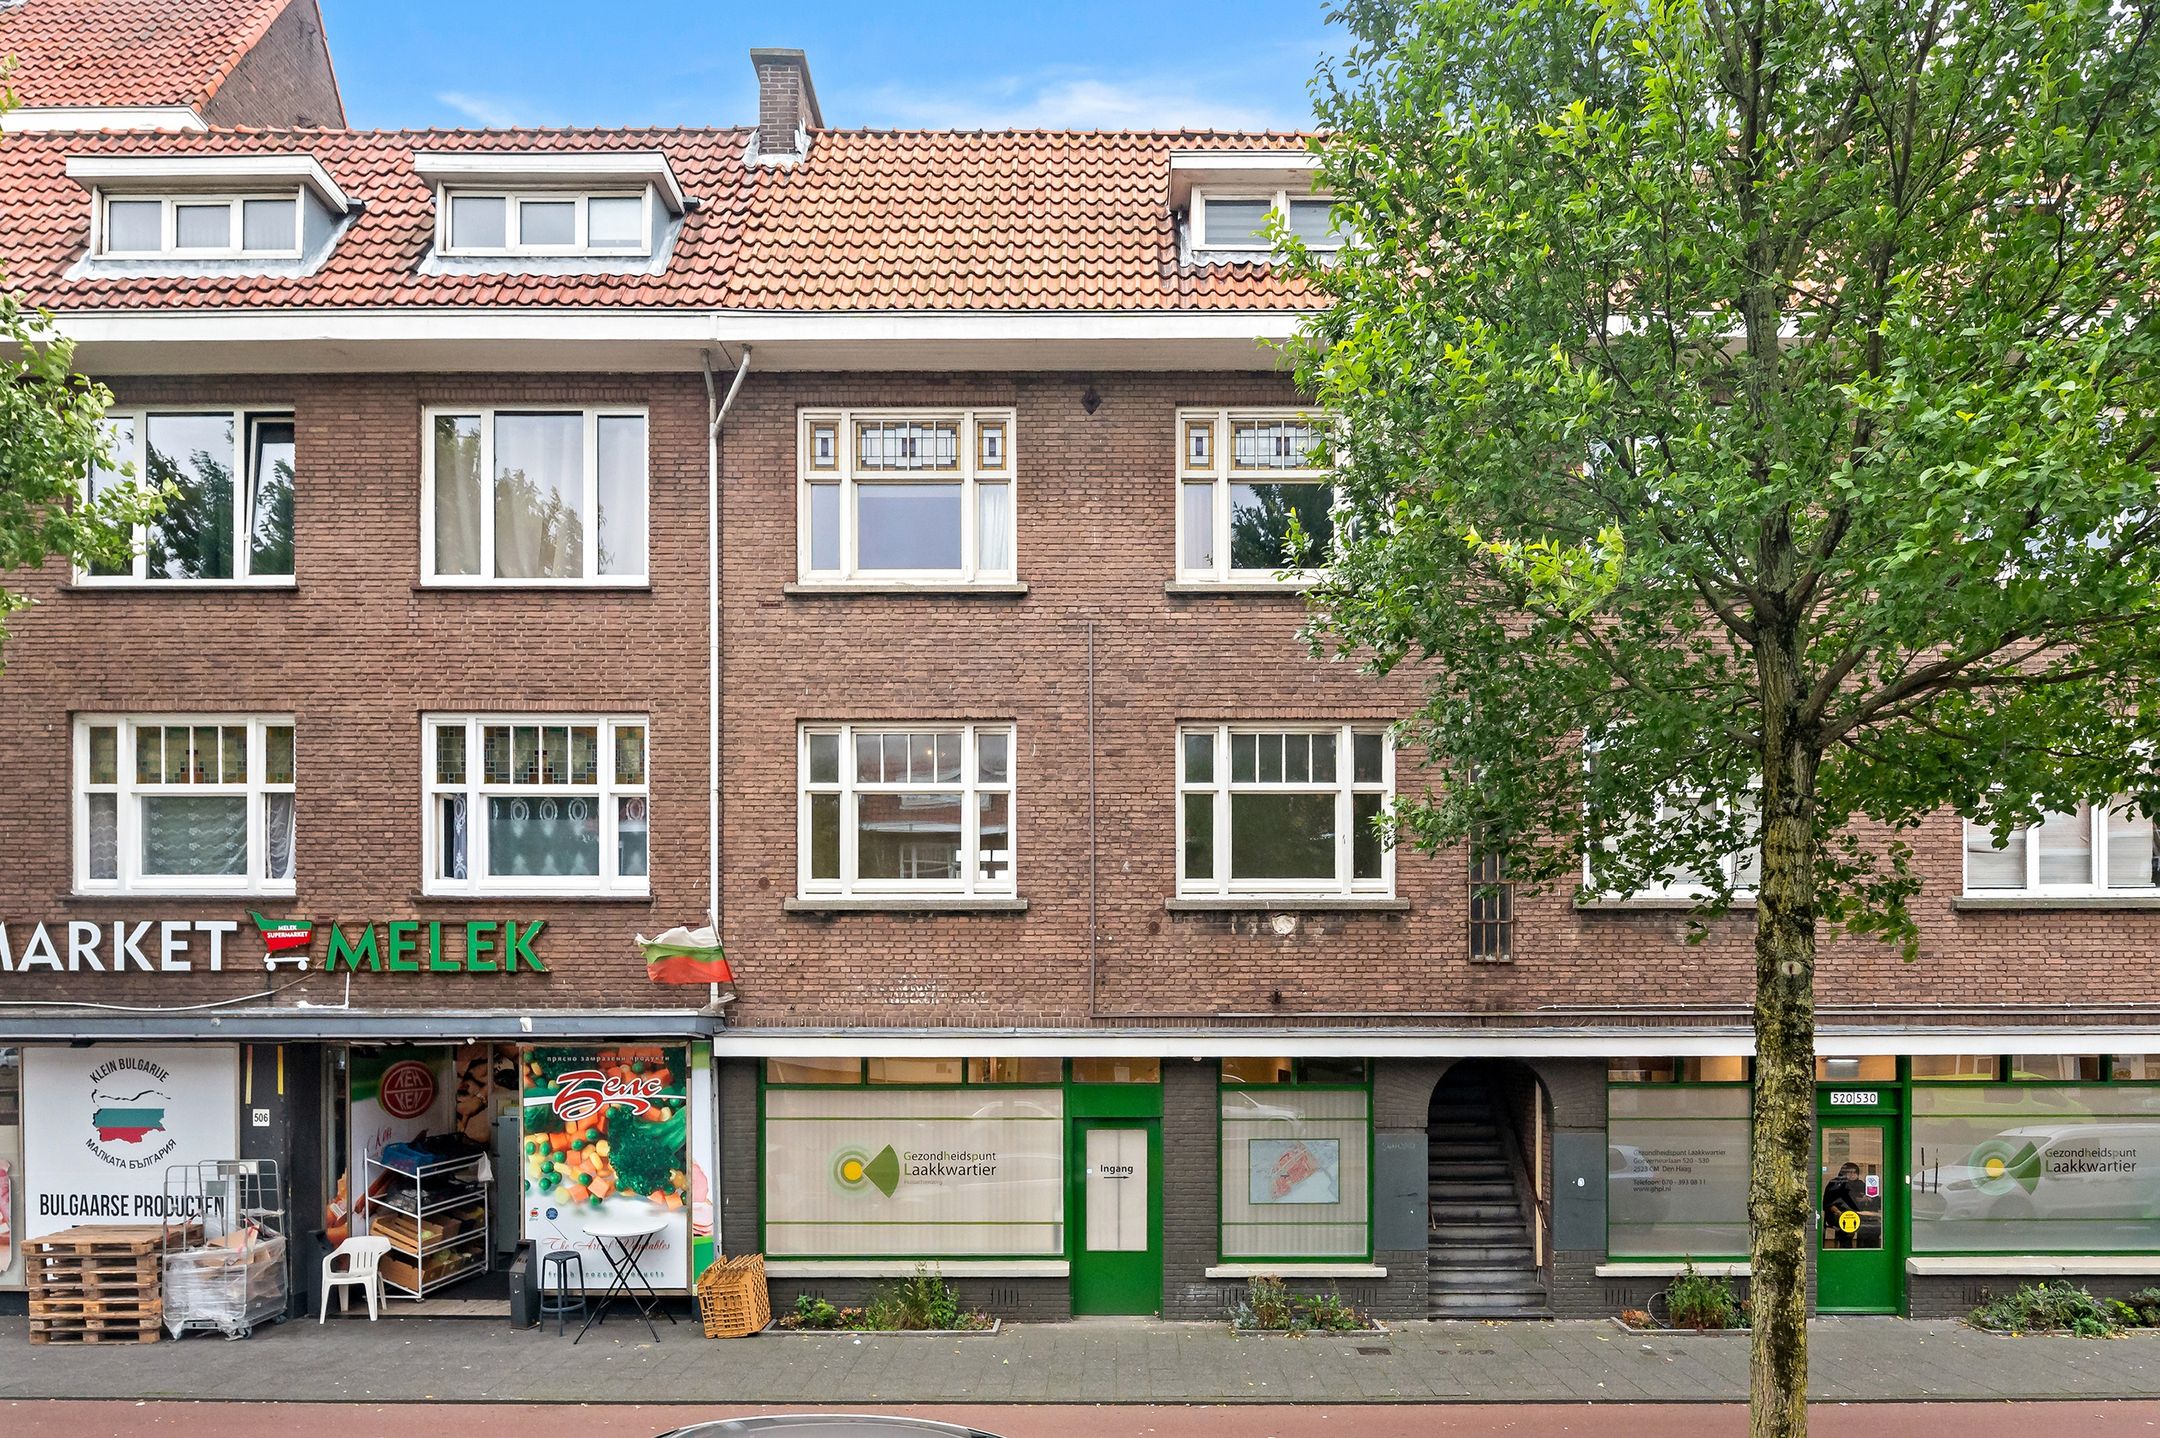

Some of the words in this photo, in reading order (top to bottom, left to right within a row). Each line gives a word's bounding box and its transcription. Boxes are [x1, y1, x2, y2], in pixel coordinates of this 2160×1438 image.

[0, 920, 238, 971] ARKET
[325, 919, 550, 972] MELEK
[89, 1060, 117, 1083] KLEIN
[118, 1057, 169, 1082] BULGARIJE
[1833, 1093, 1853, 1103] 520
[1856, 1093, 1876, 1103] 530
[254, 1113, 268, 1122] 506
[85, 1138, 126, 1168] МАЛКАТА
[129, 1138, 177, 1169] БЪЛГАРИЯ
[904, 1151, 996, 1162] Gezondheidspunt
[1634, 1149, 1687, 1157] Gezondheidspunt
[2045, 1148, 2136, 1158] Gezondheidspunt
[904, 1163, 996, 1176] Laakkwartier
[1101, 1164, 1133, 1174] Ingang
[2046, 1159, 2136, 1172] Laakkwartier
[40, 1193, 129, 1216] BULGAARSE
[135, 1194, 224, 1217] PRODUCTEN
[543, 1237, 570, 1250] The
